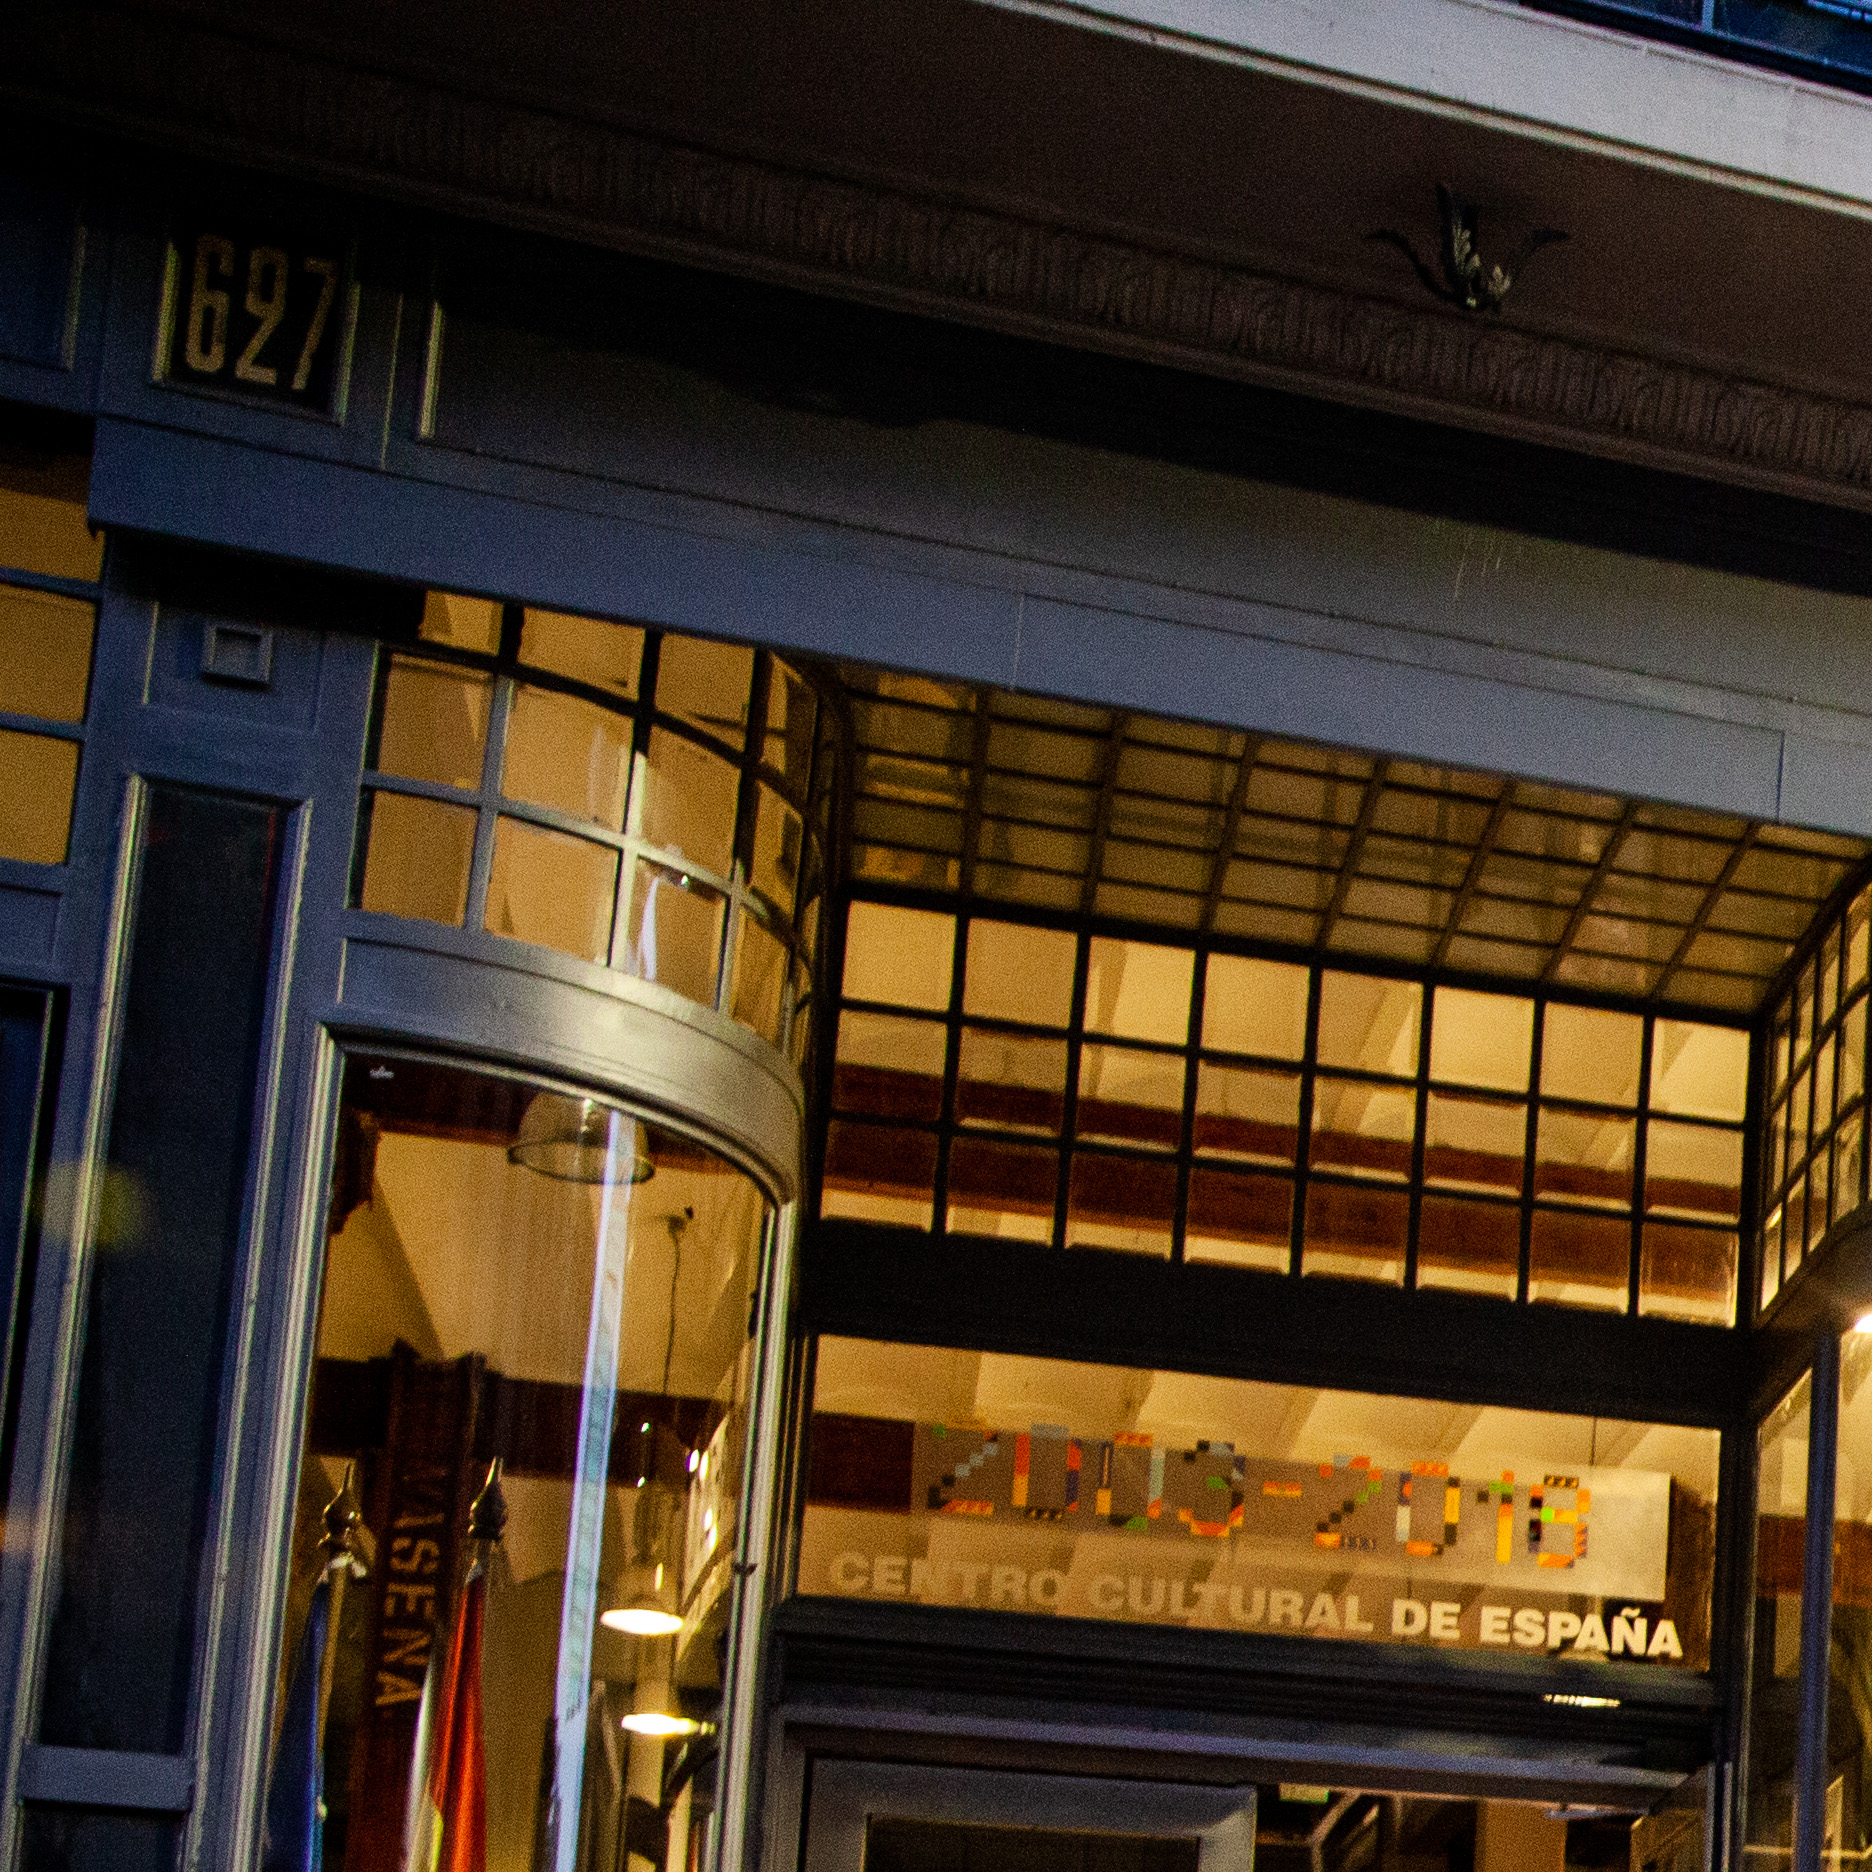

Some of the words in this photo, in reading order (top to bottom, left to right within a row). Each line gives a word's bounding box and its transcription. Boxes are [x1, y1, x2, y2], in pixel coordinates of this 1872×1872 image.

[186, 234, 337, 390] 627
[831, 1551, 1068, 1608] CENTRO
[1092, 1572, 1373, 1633] CULTURAL
[1391, 1599, 1461, 1640] DE
[1480, 1605, 1684, 1660] ESPAÑA
